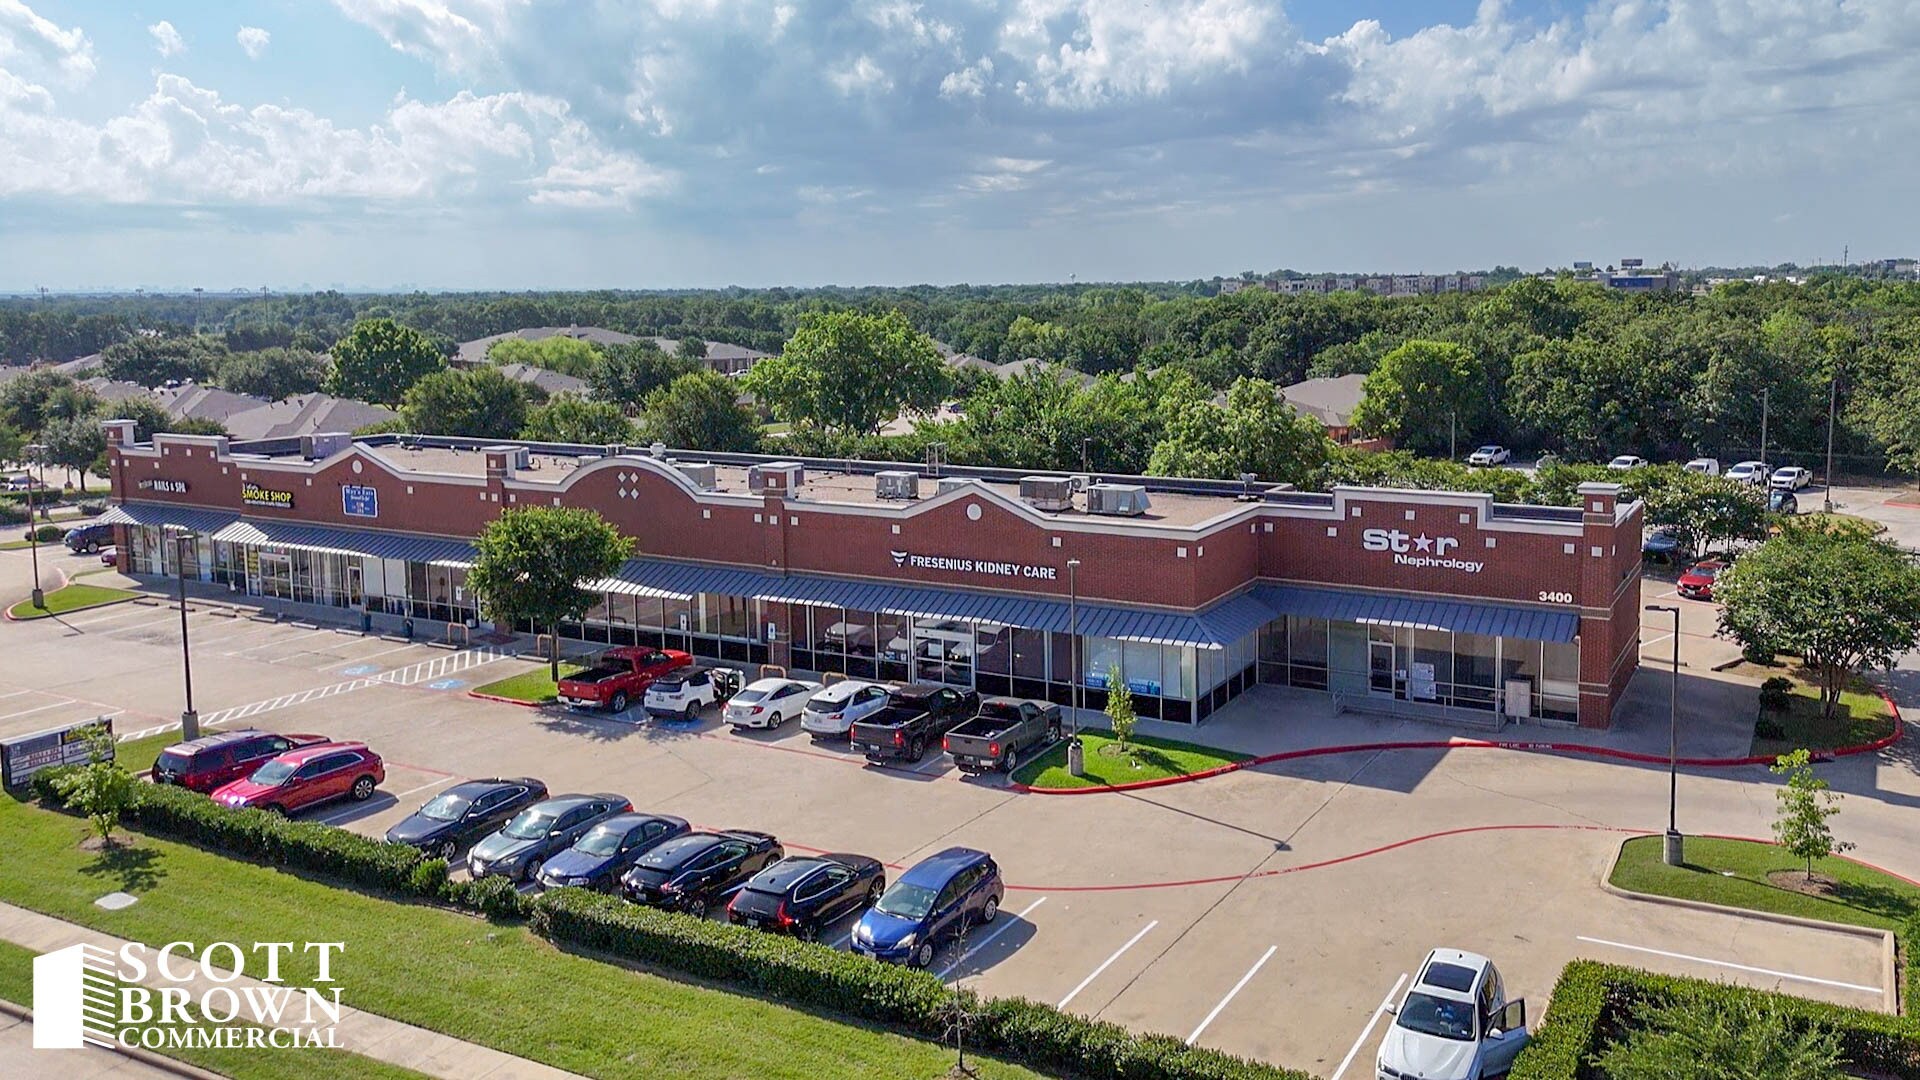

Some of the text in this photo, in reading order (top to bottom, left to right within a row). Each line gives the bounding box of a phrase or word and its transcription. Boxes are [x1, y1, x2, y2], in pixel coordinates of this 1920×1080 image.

[175, 481, 187, 493] SPA
[242, 489, 292, 502] SMOKE SHOP
[910, 555, 1056, 580] FRESENIUS KIDNEY CARE
[1393, 553, 1484, 573] Nephrology
[1538, 591, 1572, 604] 3400
